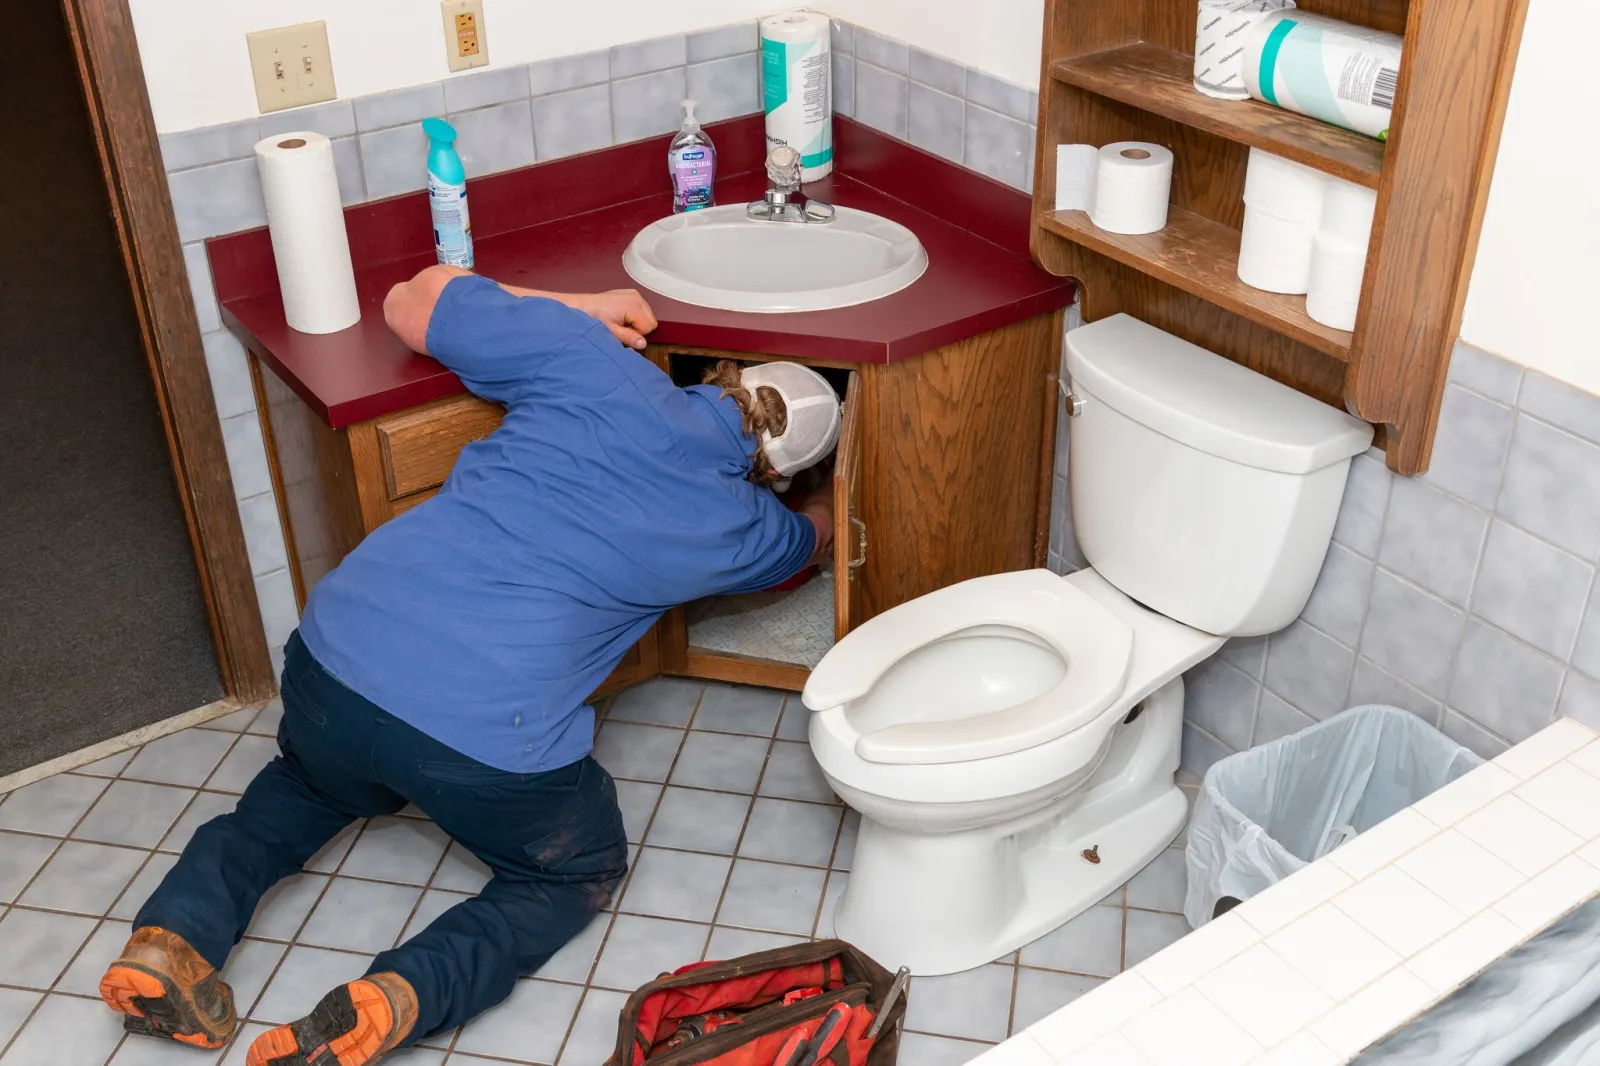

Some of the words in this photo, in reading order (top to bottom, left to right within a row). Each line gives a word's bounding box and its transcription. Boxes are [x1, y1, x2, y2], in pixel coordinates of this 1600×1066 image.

[1225, 20, 1251, 38] HIGHMARK
[1218, 47, 1244, 64] HIGHMARK
[675, 160, 712, 169] ANTIBACTERIAL
